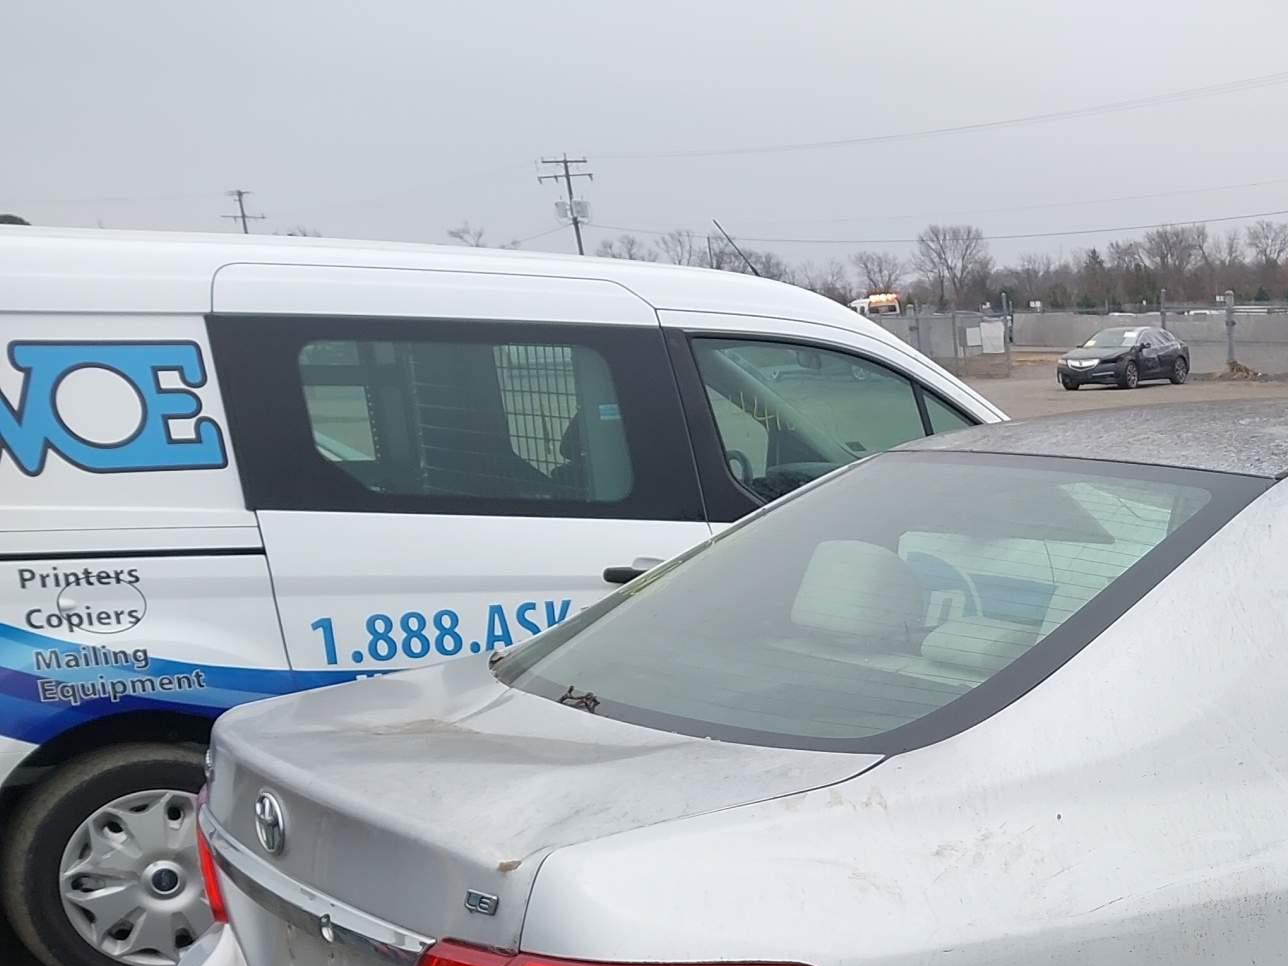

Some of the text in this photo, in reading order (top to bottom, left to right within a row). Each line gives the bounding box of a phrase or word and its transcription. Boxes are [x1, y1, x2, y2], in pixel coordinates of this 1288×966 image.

[17, 566, 141, 590] Printers
[25, 605, 142, 633] Copiers
[33, 644, 151, 672] Mailing
[37, 669, 208, 706] Equipment
